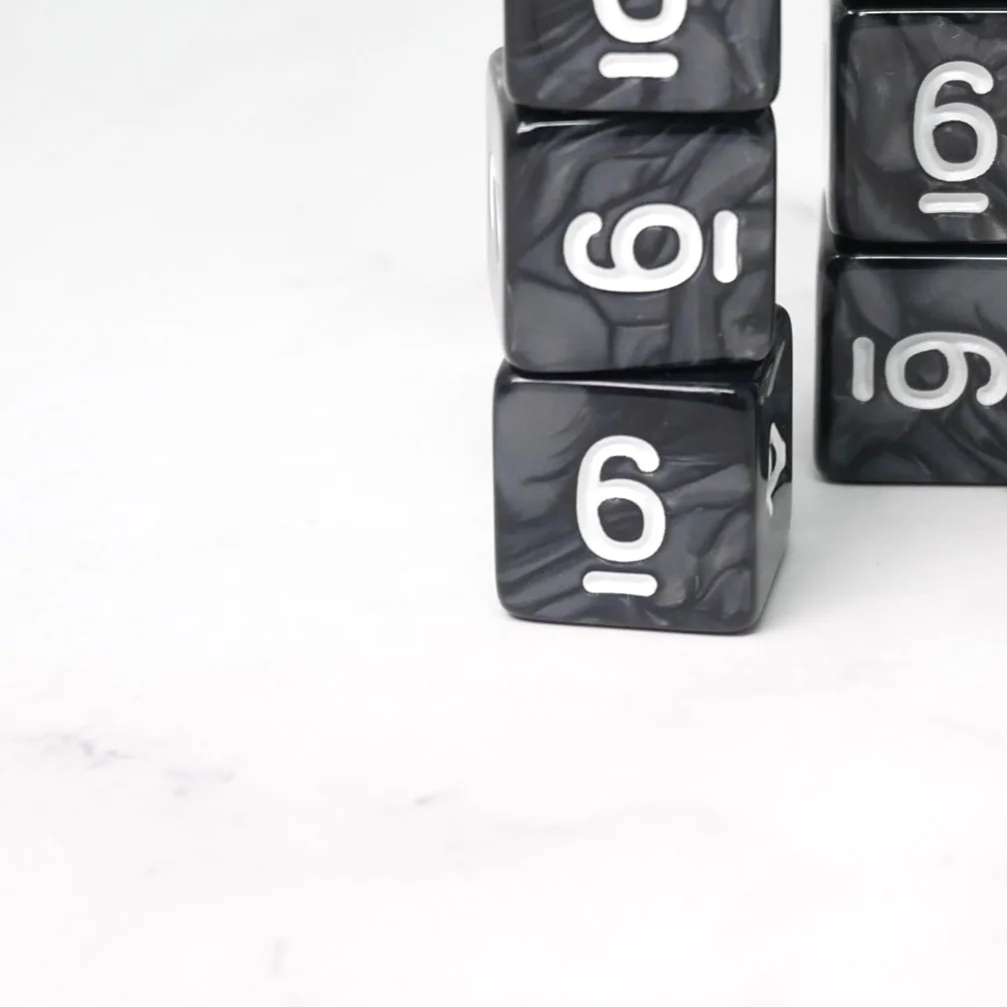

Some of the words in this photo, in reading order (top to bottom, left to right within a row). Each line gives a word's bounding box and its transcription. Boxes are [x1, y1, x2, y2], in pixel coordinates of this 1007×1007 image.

[914, 61, 997, 213] 6
[564, 204, 740, 292] 6
[576, 436, 665, 597] 6
